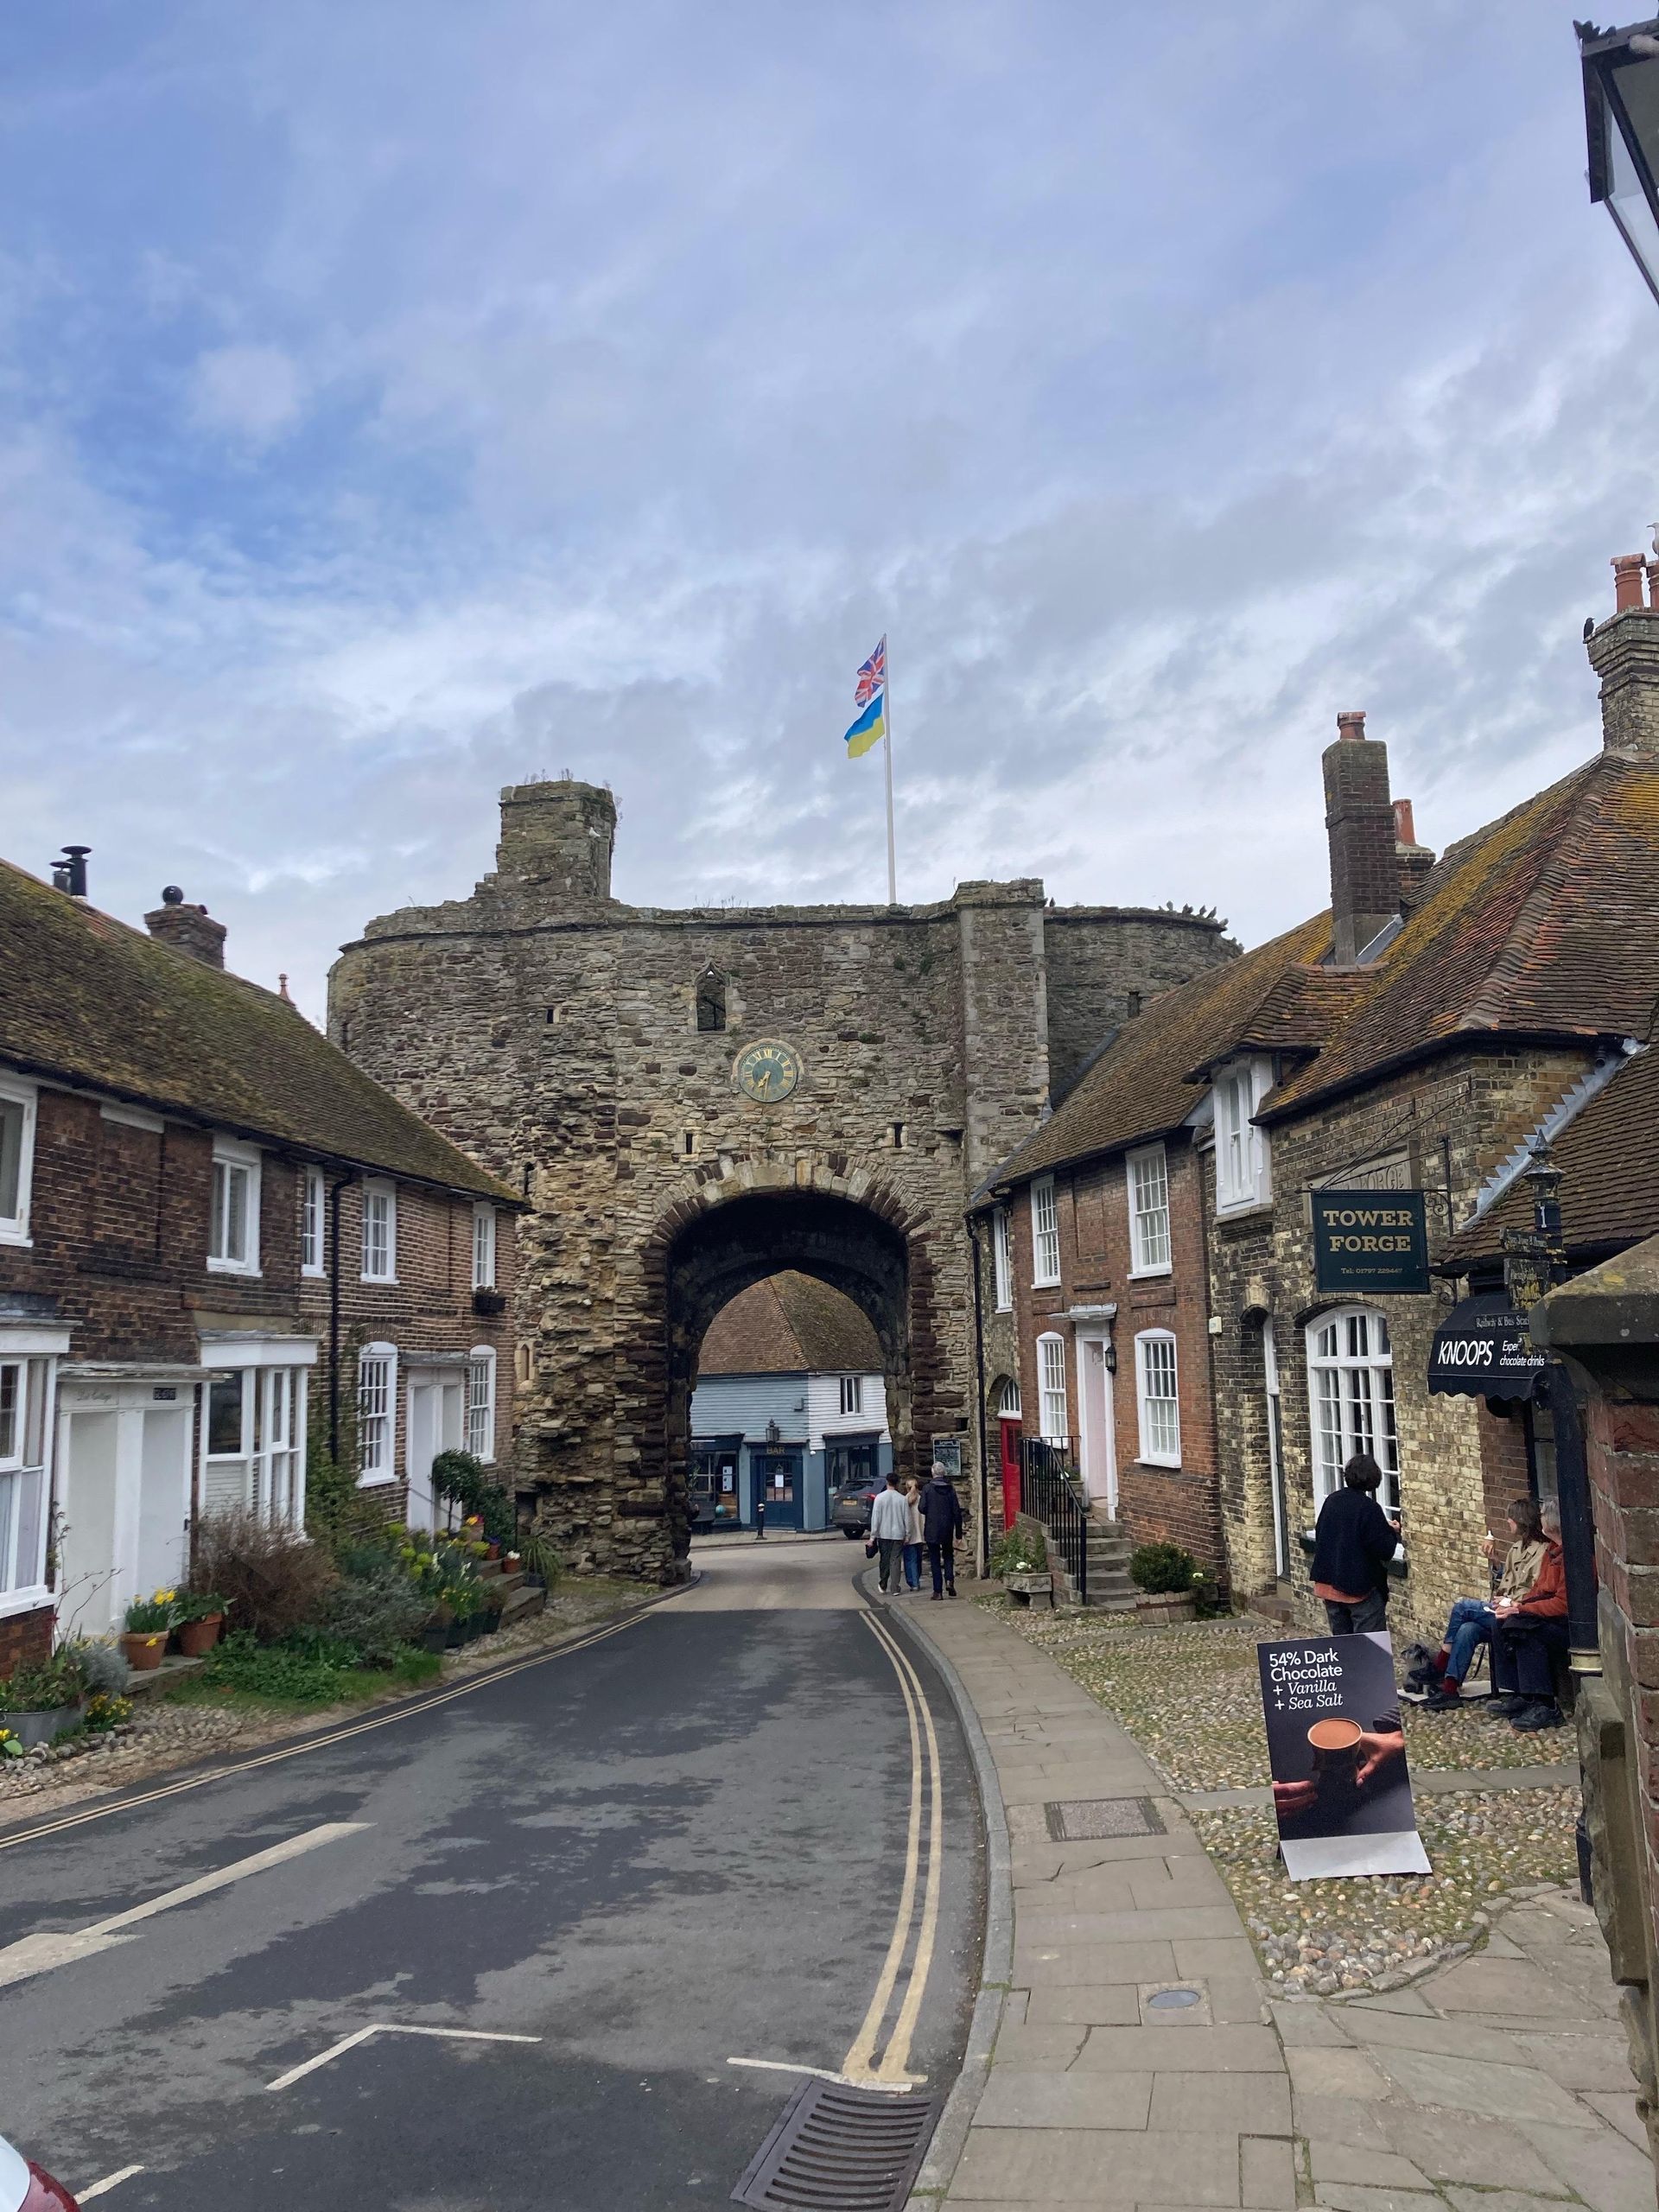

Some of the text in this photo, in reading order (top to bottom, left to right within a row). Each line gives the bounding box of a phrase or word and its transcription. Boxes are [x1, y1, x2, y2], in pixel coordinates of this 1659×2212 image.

[1323, 1210, 1414, 1226] TOWER
[1329, 1236, 1411, 1252] FORGE
[1497, 1316, 1504, 1326] &
[1504, 1316, 1515, 1326] Bus
[1438, 1340, 1494, 1366] KNOOPS
[1502, 1340, 1520, 1354] Exper
[1499, 1354, 1545, 1366] chocolate drinks
[1269, 1647, 1339, 1668] 54% Dark
[1270, 1663, 1343, 1681] Chocolate
[1287, 1680, 1337, 1694] Vanilla
[1288, 1696, 1313, 1710] Sea
[1316, 1693, 1344, 1707] Salt
